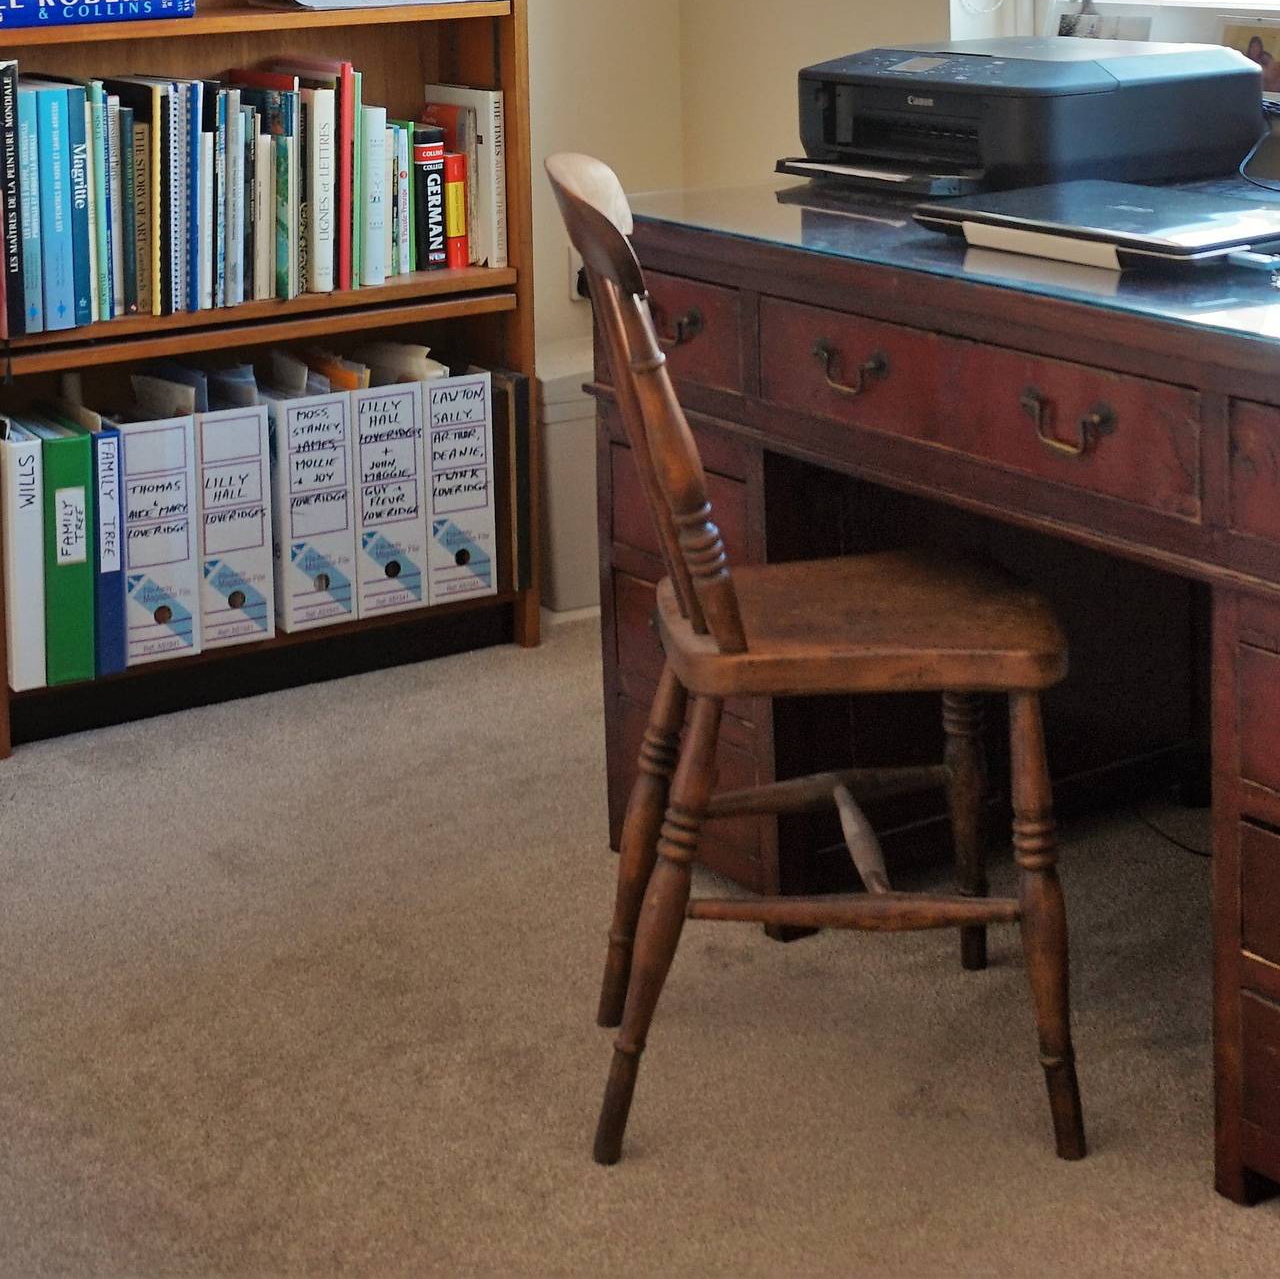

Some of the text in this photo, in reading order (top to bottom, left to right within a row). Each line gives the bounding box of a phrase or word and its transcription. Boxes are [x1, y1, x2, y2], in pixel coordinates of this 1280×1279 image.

[38, 0, 153, 20] & COLLINS
[135, 127, 145, 155] THE
[318, 123, 330, 177] LETTRES
[494, 124, 502, 156] TIMES
[4, 75, 19, 274] LES MAÎTRES DE LA PEINTURE MONDIALE
[70, 143, 88, 208] Magritte
[135, 159, 146, 199] STORY
[136, 200, 146, 215] OF
[427, 173, 443, 249] GERMAN
[318, 197, 330, 242] LIGNES
[136, 220, 147, 243] ART
[360, 400, 402, 415] LILLY
[369, 414, 399, 428] HALL
[296, 457, 336, 471] MOLLIE
[18, 454, 35, 509] WILLS
[128, 479, 181, 494] THOMAS
[205, 473, 249, 490] LILLY
[314, 473, 335, 484] JOY
[101, 441, 116, 558] FAMILY TREE
[213, 488, 247, 503] HALL
[291, 490, 348, 509] LOVERIDGE
[365, 484, 387, 497] GUY
[370, 494, 405, 507] FLEUR
[74, 506, 85, 544] TREE
[204, 507, 267, 525] LOVERIDGES
[60, 499, 75, 557] FAMILY
